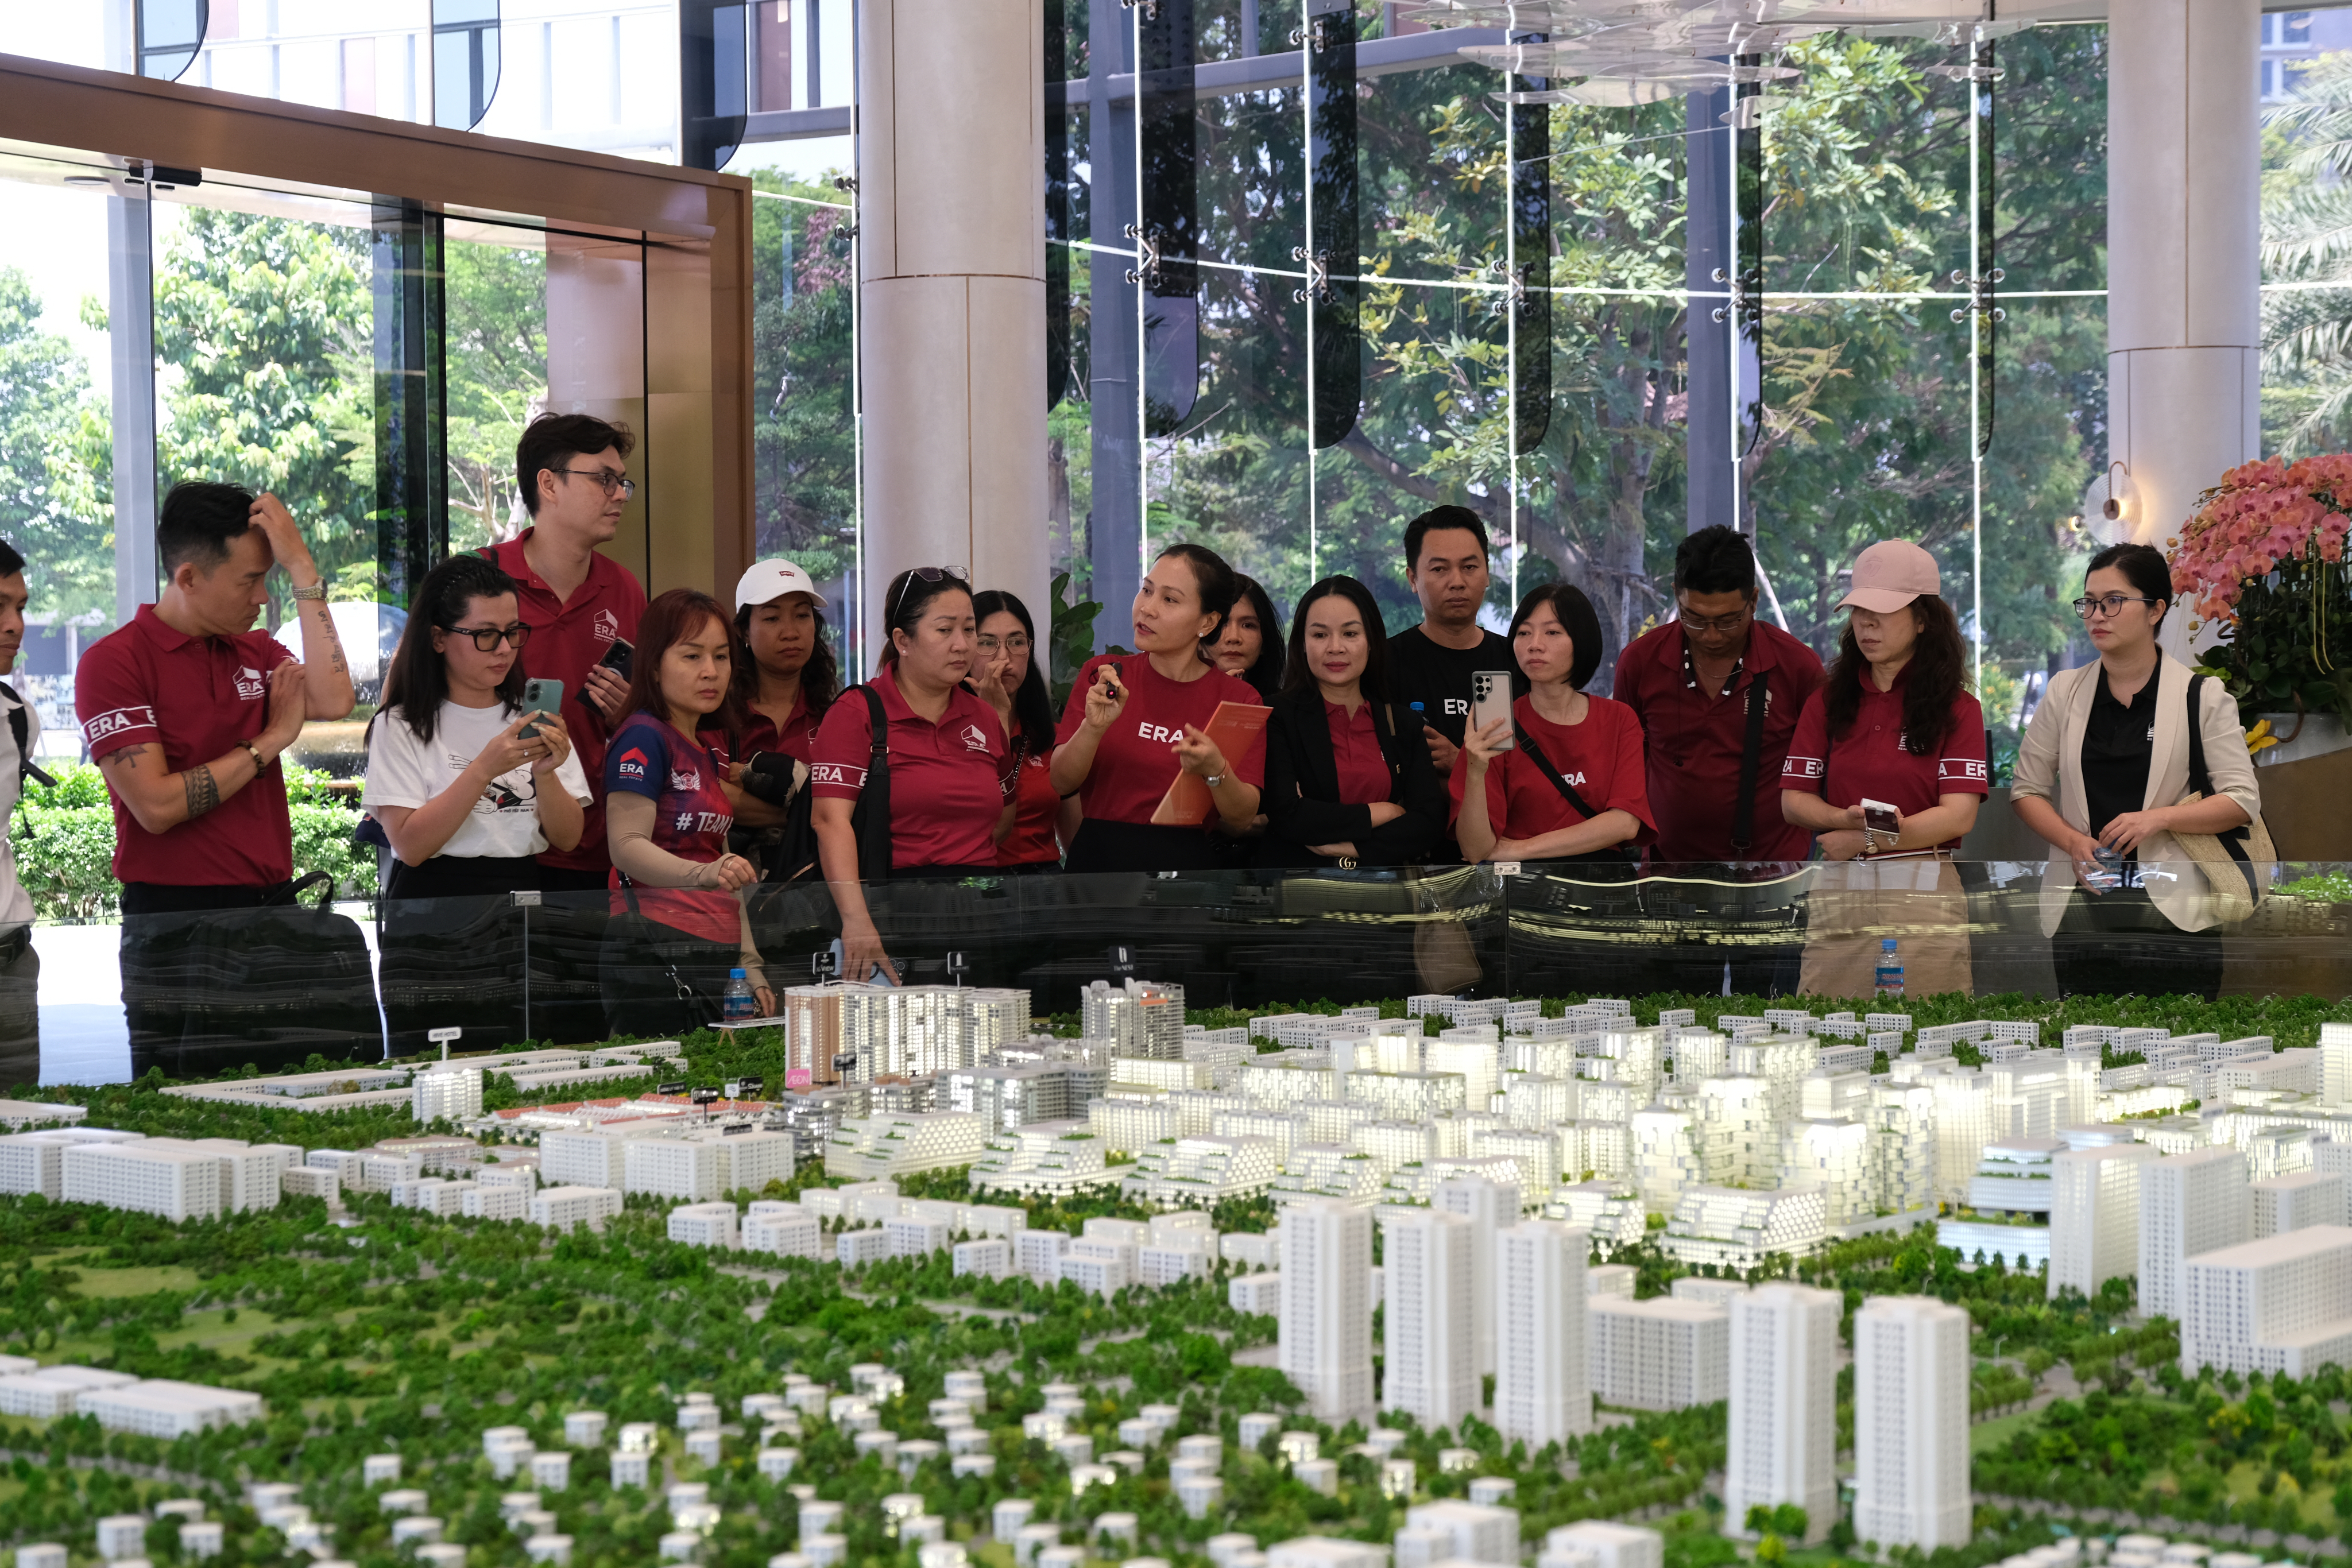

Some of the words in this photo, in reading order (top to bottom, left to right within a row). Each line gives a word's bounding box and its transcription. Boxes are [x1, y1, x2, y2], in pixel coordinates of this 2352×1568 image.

[595, 623, 616, 638] ERA
[236, 682, 264, 694] ERA
[1444, 698, 1468, 715] ER
[88, 713, 131, 740] ERA
[1138, 722, 1184, 744] ERA
[620, 763, 644, 776] ERA
[811, 766, 843, 782] ERA
[1561, 771, 1587, 787] RA
[697, 812, 730, 835] TEAM
